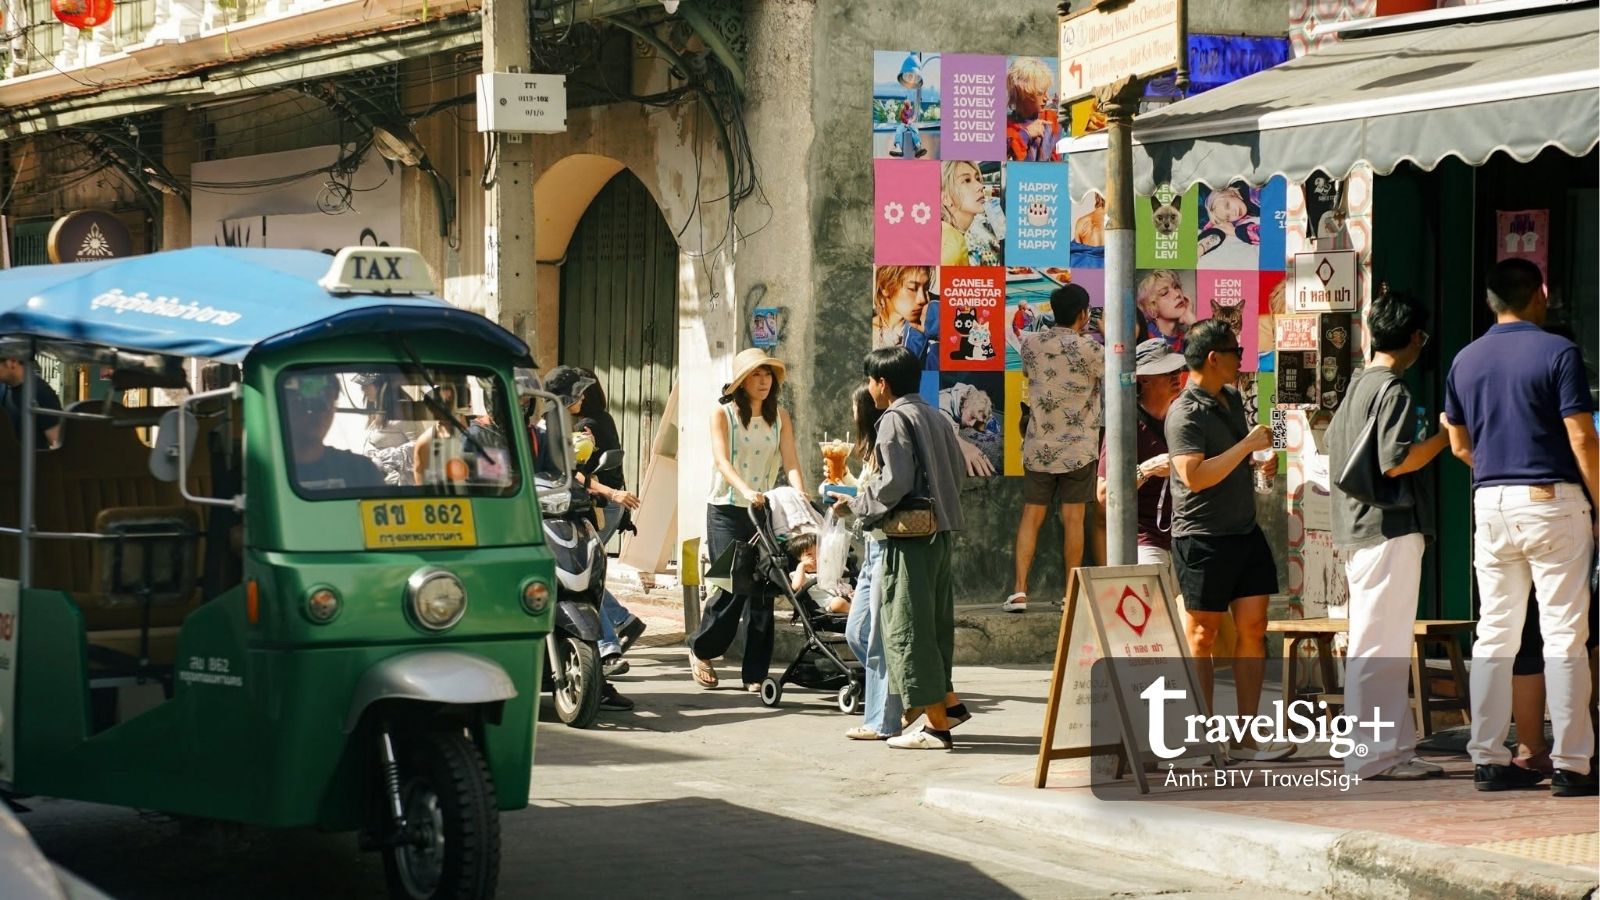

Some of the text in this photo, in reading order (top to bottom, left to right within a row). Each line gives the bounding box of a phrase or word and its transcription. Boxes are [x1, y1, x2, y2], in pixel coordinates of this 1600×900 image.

[952, 74, 995, 84] 10VELY
[952, 86, 995, 96] 10VELY
[952, 97, 995, 107] 10VELY
[952, 109, 995, 119] 10VELY
[952, 121, 995, 130] 10VELY
[952, 132, 995, 142] 10VELY
[1019, 182, 1058, 192] HAPPY
[1018, 228, 1058, 238] HAPPY
[1018, 240, 1057, 250] HAPPY
[1156, 241, 1178, 250] LEVI
[1155, 250, 1178, 259] LEVI
[952, 278, 994, 288] CANELE
[1214, 279, 1242, 288] LEON
[944, 288, 1002, 297] CANASTAR
[1214, 288, 1242, 297] LEON
[949, 298, 997, 307] CANIBOO
[424, 504, 463, 524] 862
